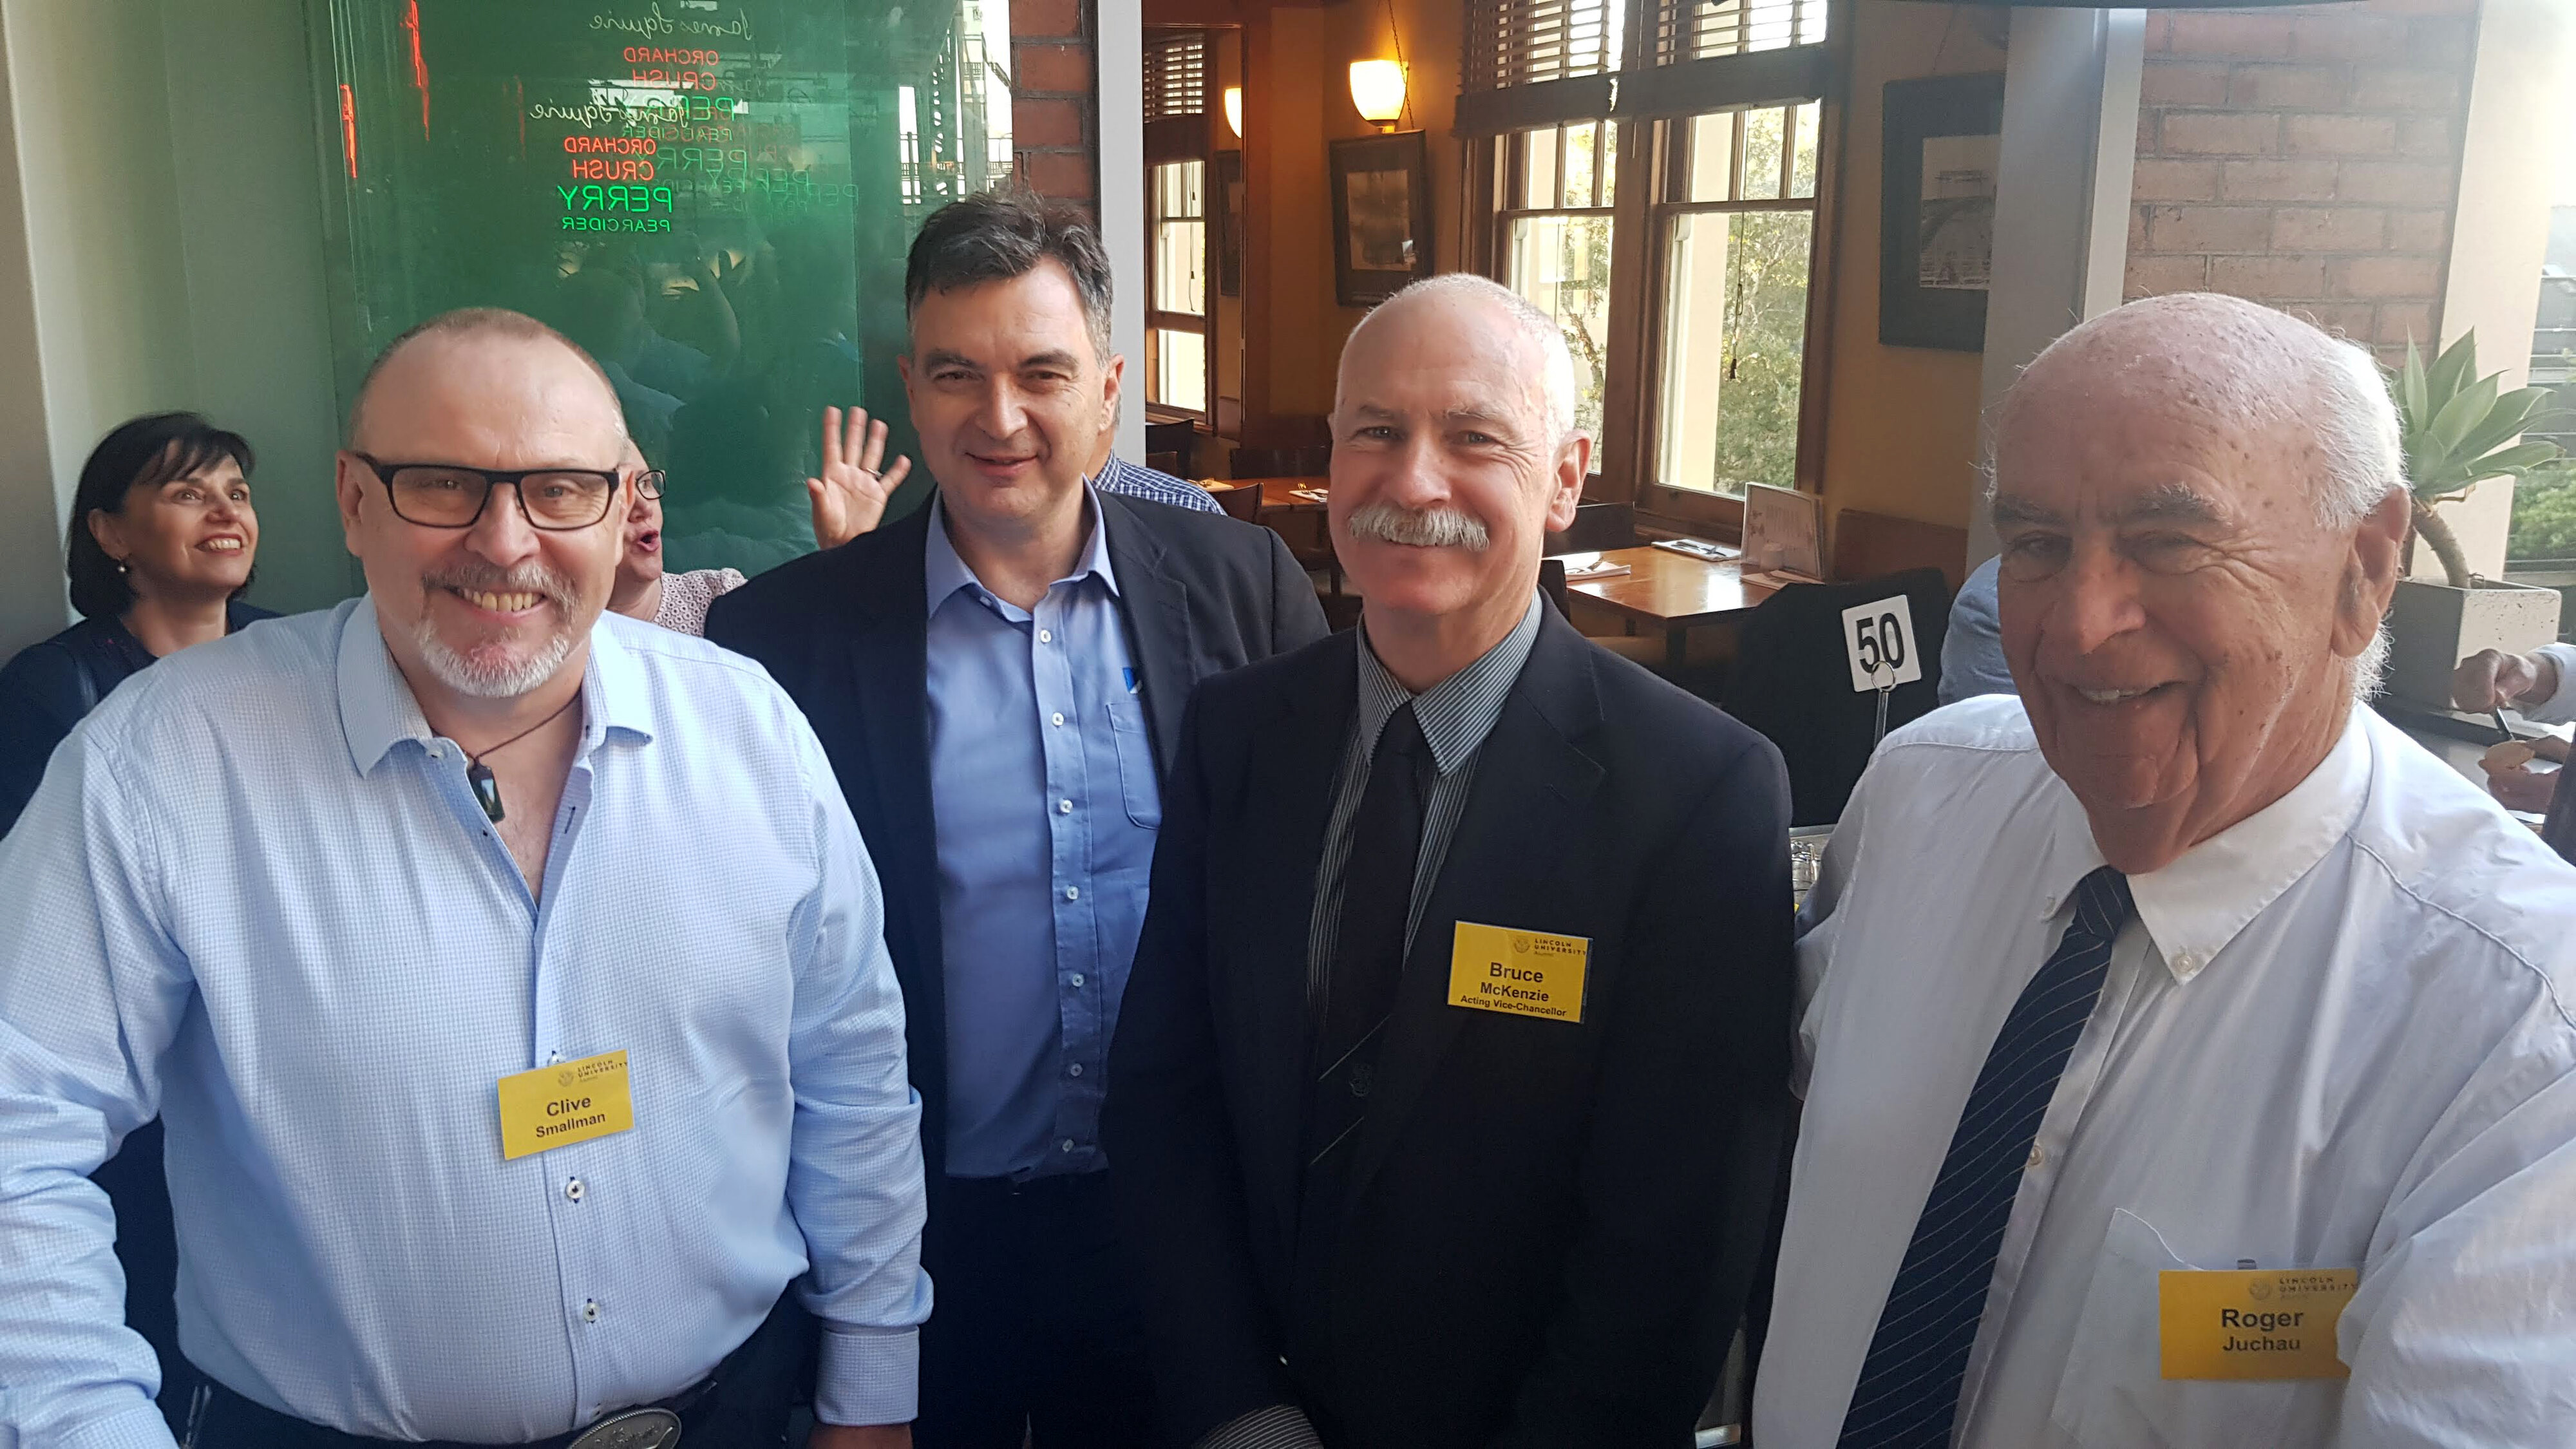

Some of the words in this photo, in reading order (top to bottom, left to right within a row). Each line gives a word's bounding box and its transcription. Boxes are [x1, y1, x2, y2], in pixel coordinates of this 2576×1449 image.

[1856, 612, 1905, 674] 50
[1535, 938, 1572, 947] LINCOLN
[1535, 945, 1586, 956] UNIVERSITY
[1490, 962, 1544, 983] Bruce
[1481, 982, 1549, 1002] McKenzie
[1461, 995, 1490, 1008] Acting
[1493, 999, 1567, 1017] Vice-Chancellor
[578, 1060, 613, 1072] LINCOLN
[578, 1062, 628, 1078] UNIVERSITY
[547, 1097, 591, 1116] Clive
[536, 1113, 606, 1138] Smallman
[2222, 1309, 2304, 1332] Roger
[2222, 1336, 2301, 1351] Juchau
